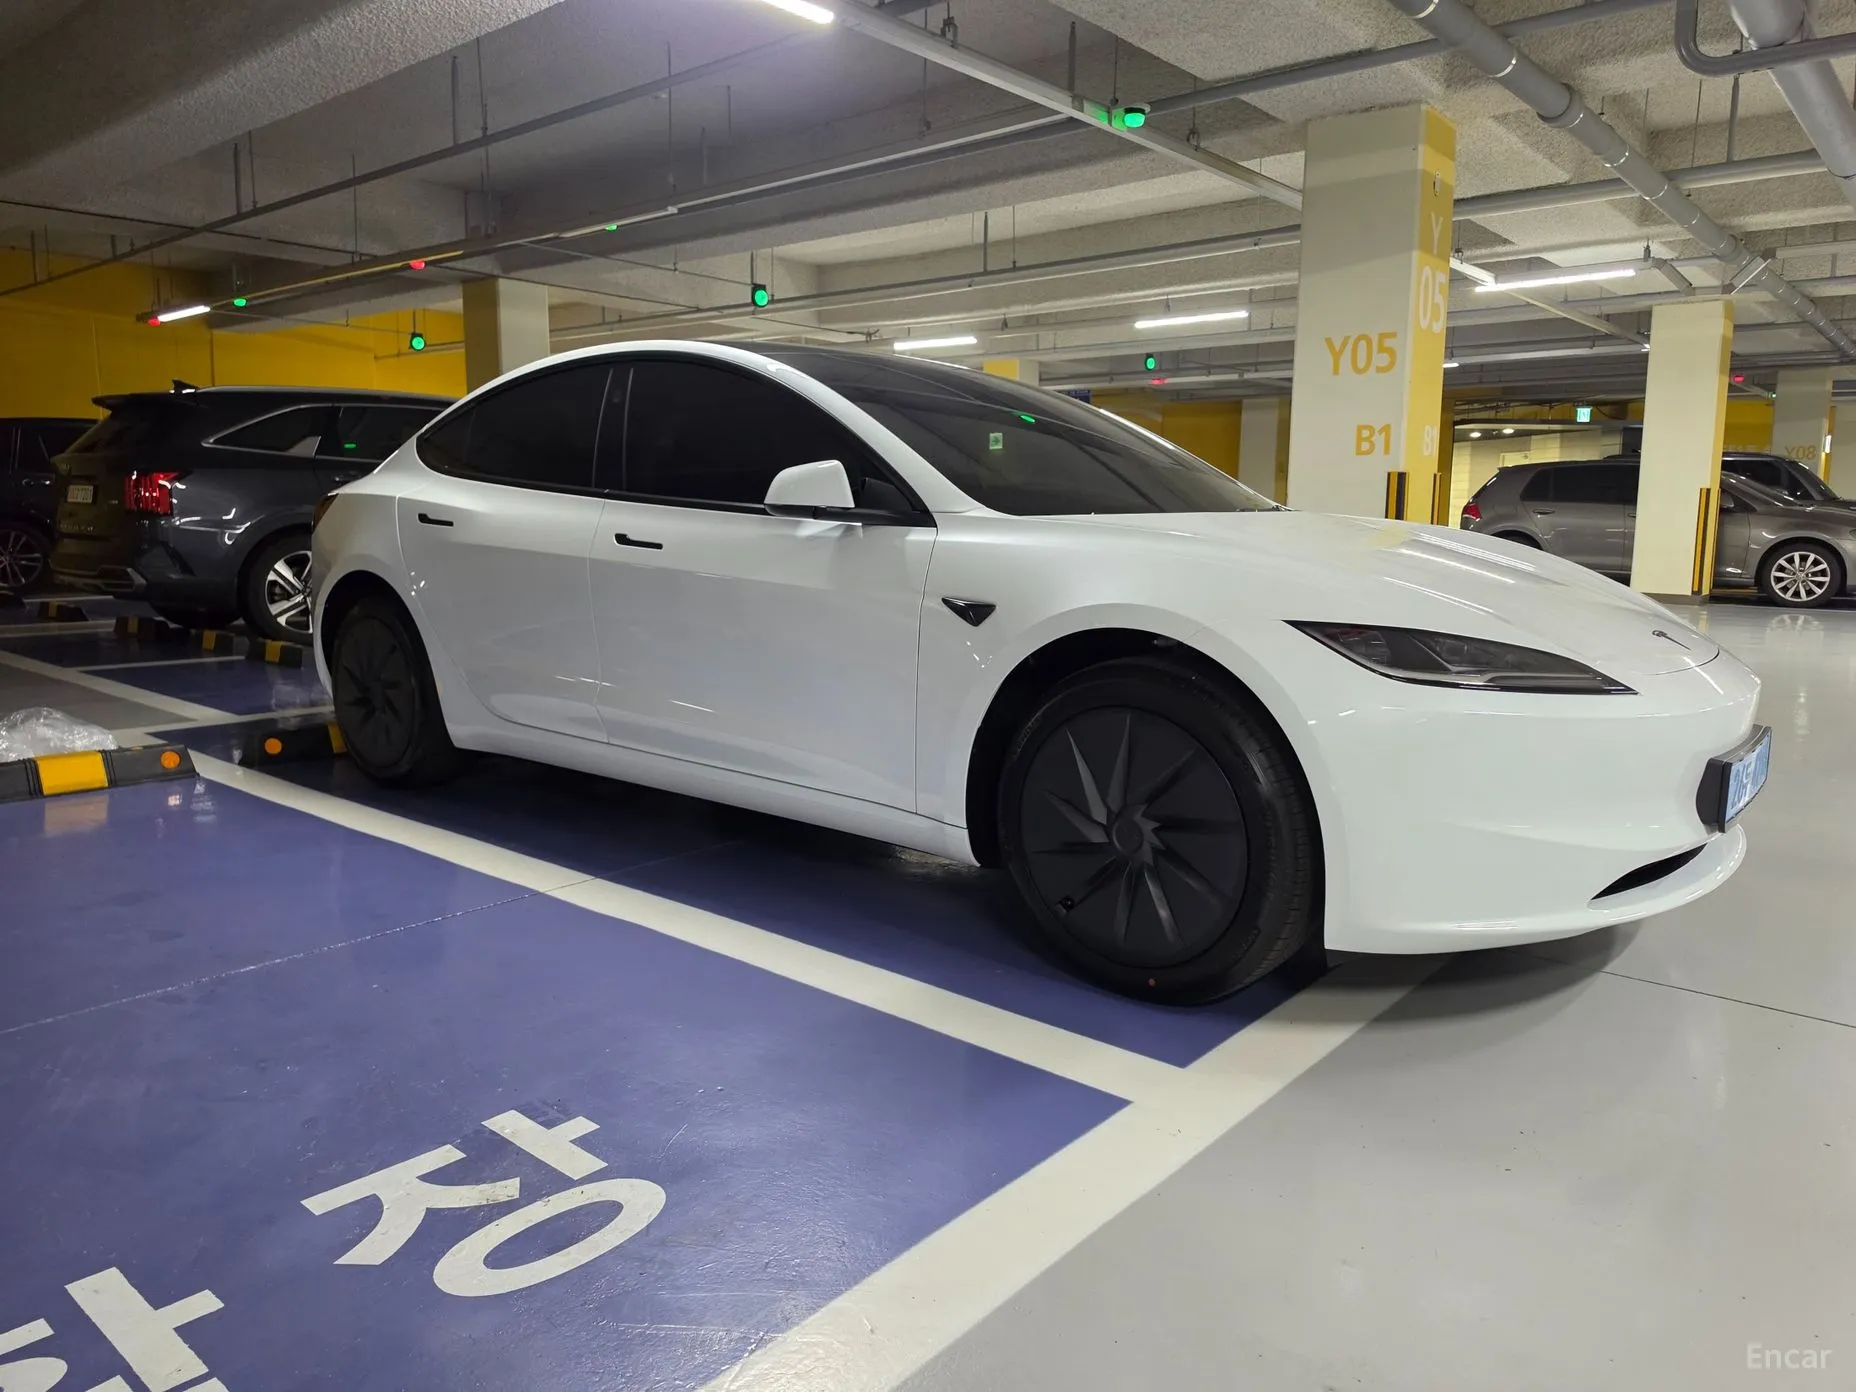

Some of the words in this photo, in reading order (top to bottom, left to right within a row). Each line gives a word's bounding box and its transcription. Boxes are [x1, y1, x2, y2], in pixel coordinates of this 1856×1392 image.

[1430, 211, 1444, 256] Y
[1418, 265, 1446, 334] 05
[1324, 331, 1398, 376] Y05
[1354, 423, 1392, 456] B1
[1423, 425, 1437, 457] B1
[1784, 444, 1817, 461] Y08
